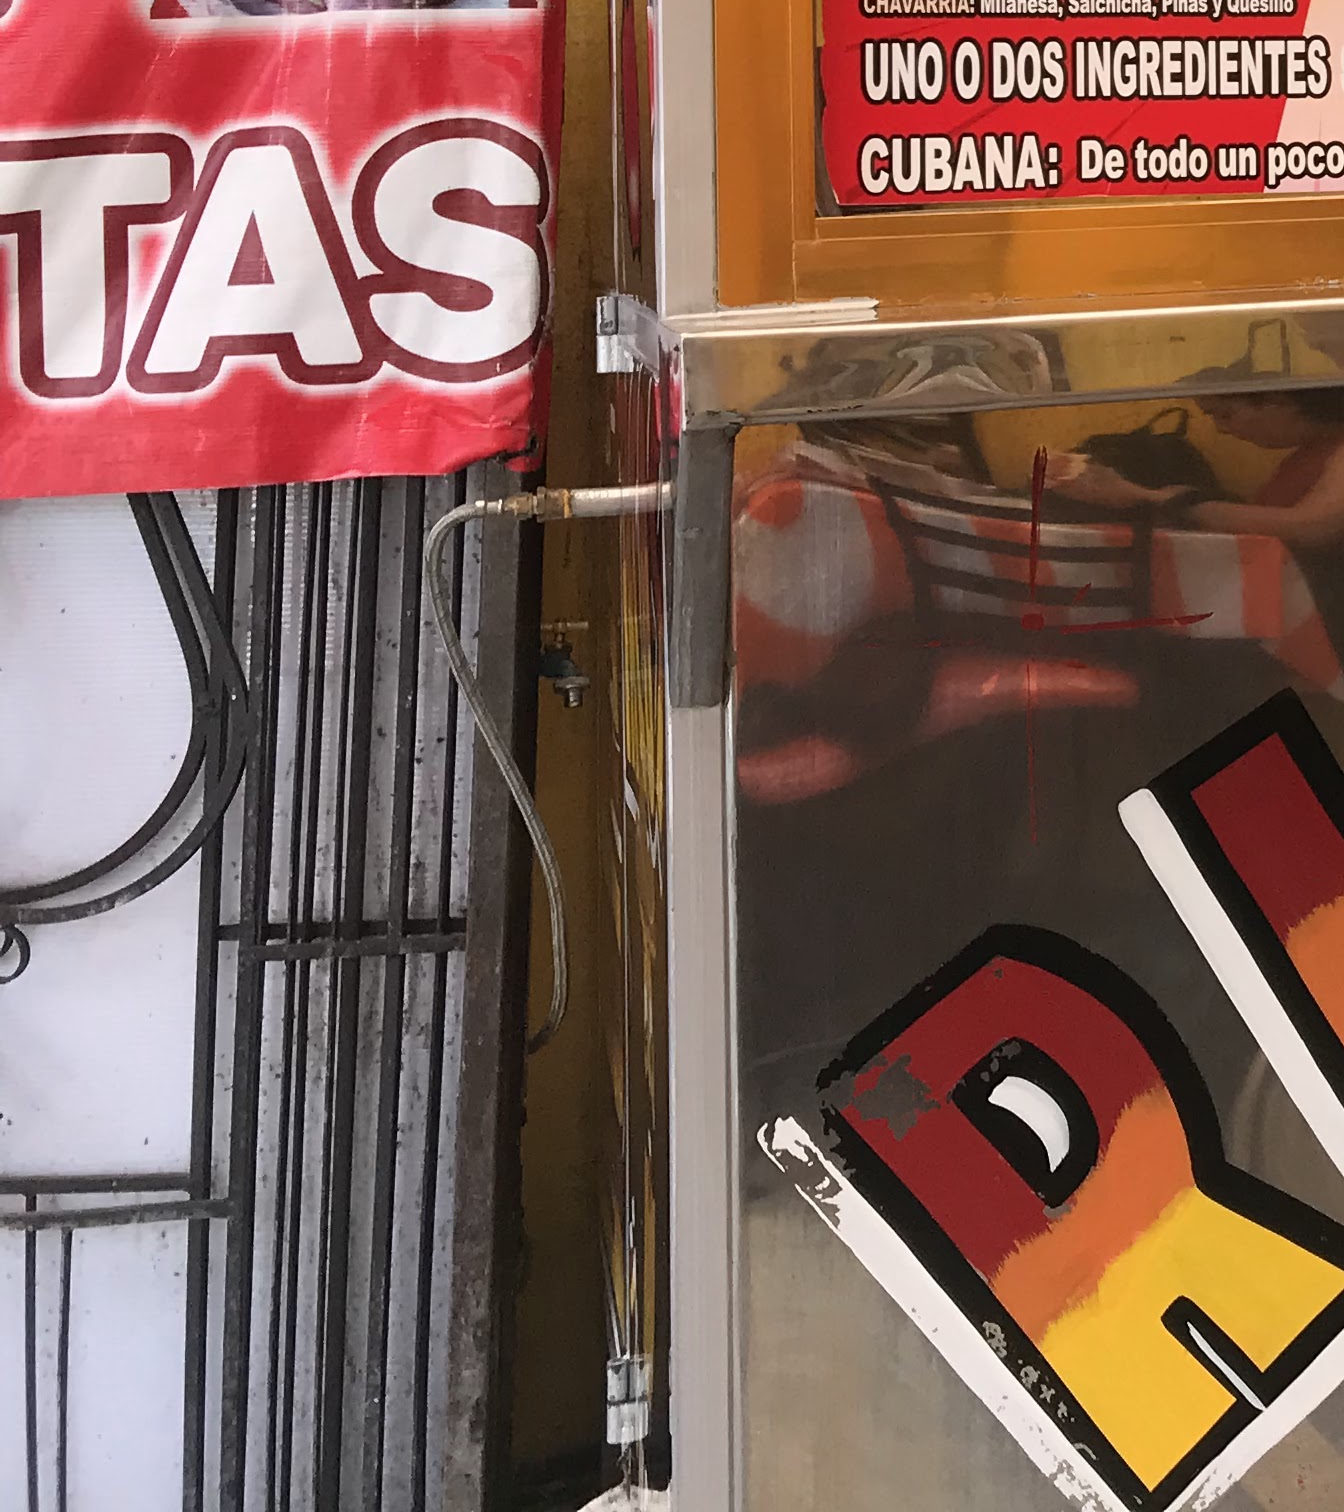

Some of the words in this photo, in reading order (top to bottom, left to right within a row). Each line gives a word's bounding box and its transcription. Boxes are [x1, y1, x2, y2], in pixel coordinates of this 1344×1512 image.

[1213, 0, 1223, 17] y
[864, 43, 944, 101] UNO
[954, 43, 981, 100] O
[994, 42, 1065, 99] DOS
[1075, 40, 1329, 98] INGREDIENTES
[860, 137, 1059, 192] CUBANA:
[1080, 140, 1124, 180] De
[1135, 140, 1208, 179] todo
[1219, 146, 1257, 178] un
